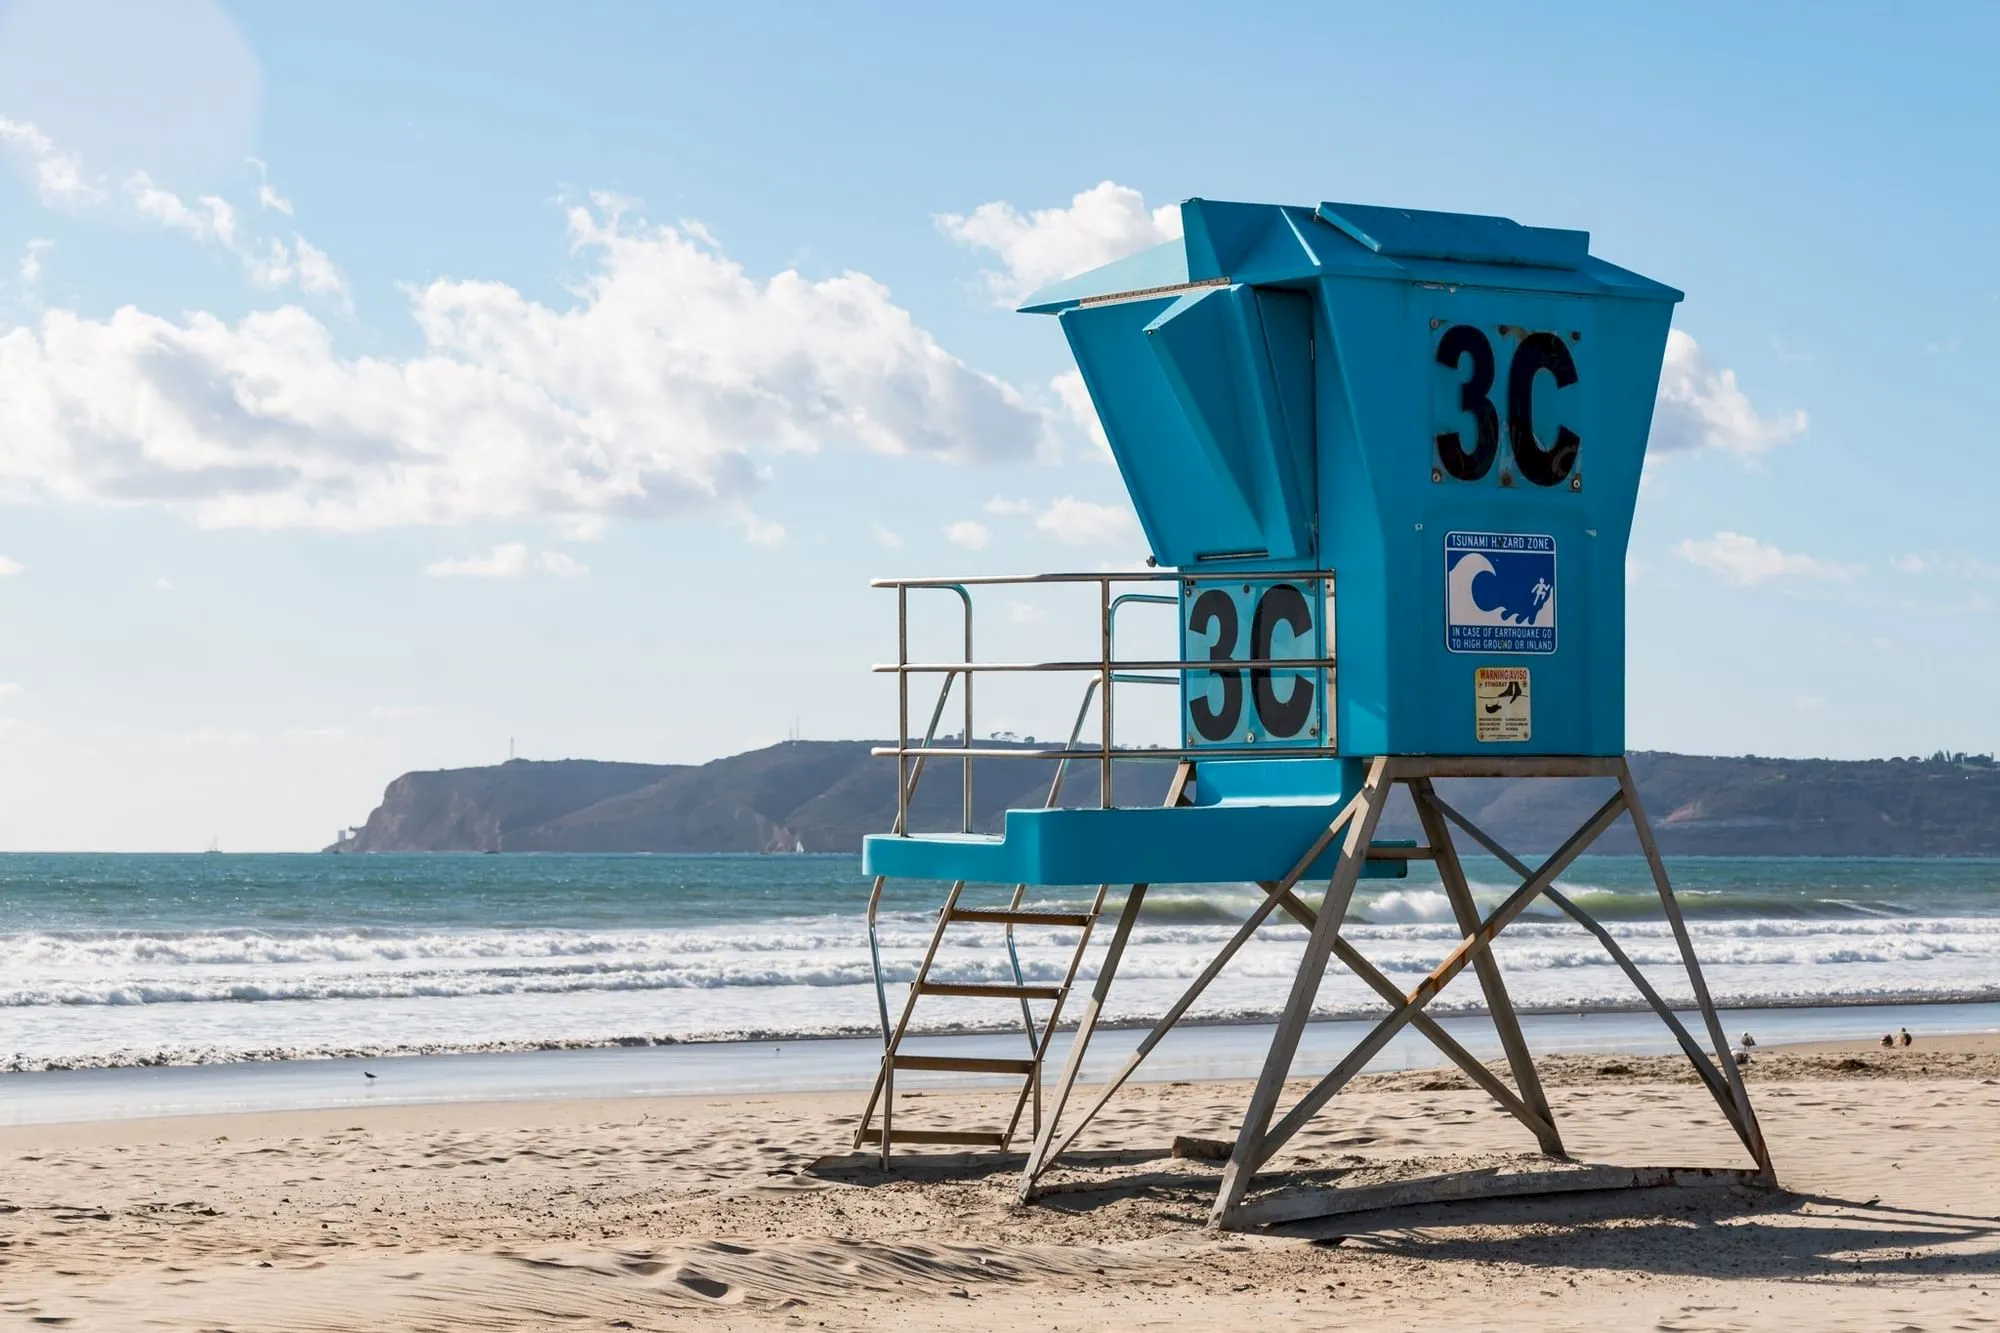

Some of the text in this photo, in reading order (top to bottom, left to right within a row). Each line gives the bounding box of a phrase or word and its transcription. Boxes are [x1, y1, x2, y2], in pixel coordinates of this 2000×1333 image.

[1436, 325, 1581, 486] 3C
[1452, 535, 1488, 547] TSUNAMI
[1527, 538, 1549, 549] ZONE
[1452, 627, 1552, 638] IN CASE OF EARTHQUAKE GO
[1452, 639, 1553, 650] TO HIGH GROUND OR INLAND
[1189, 584, 1314, 742] 3C
